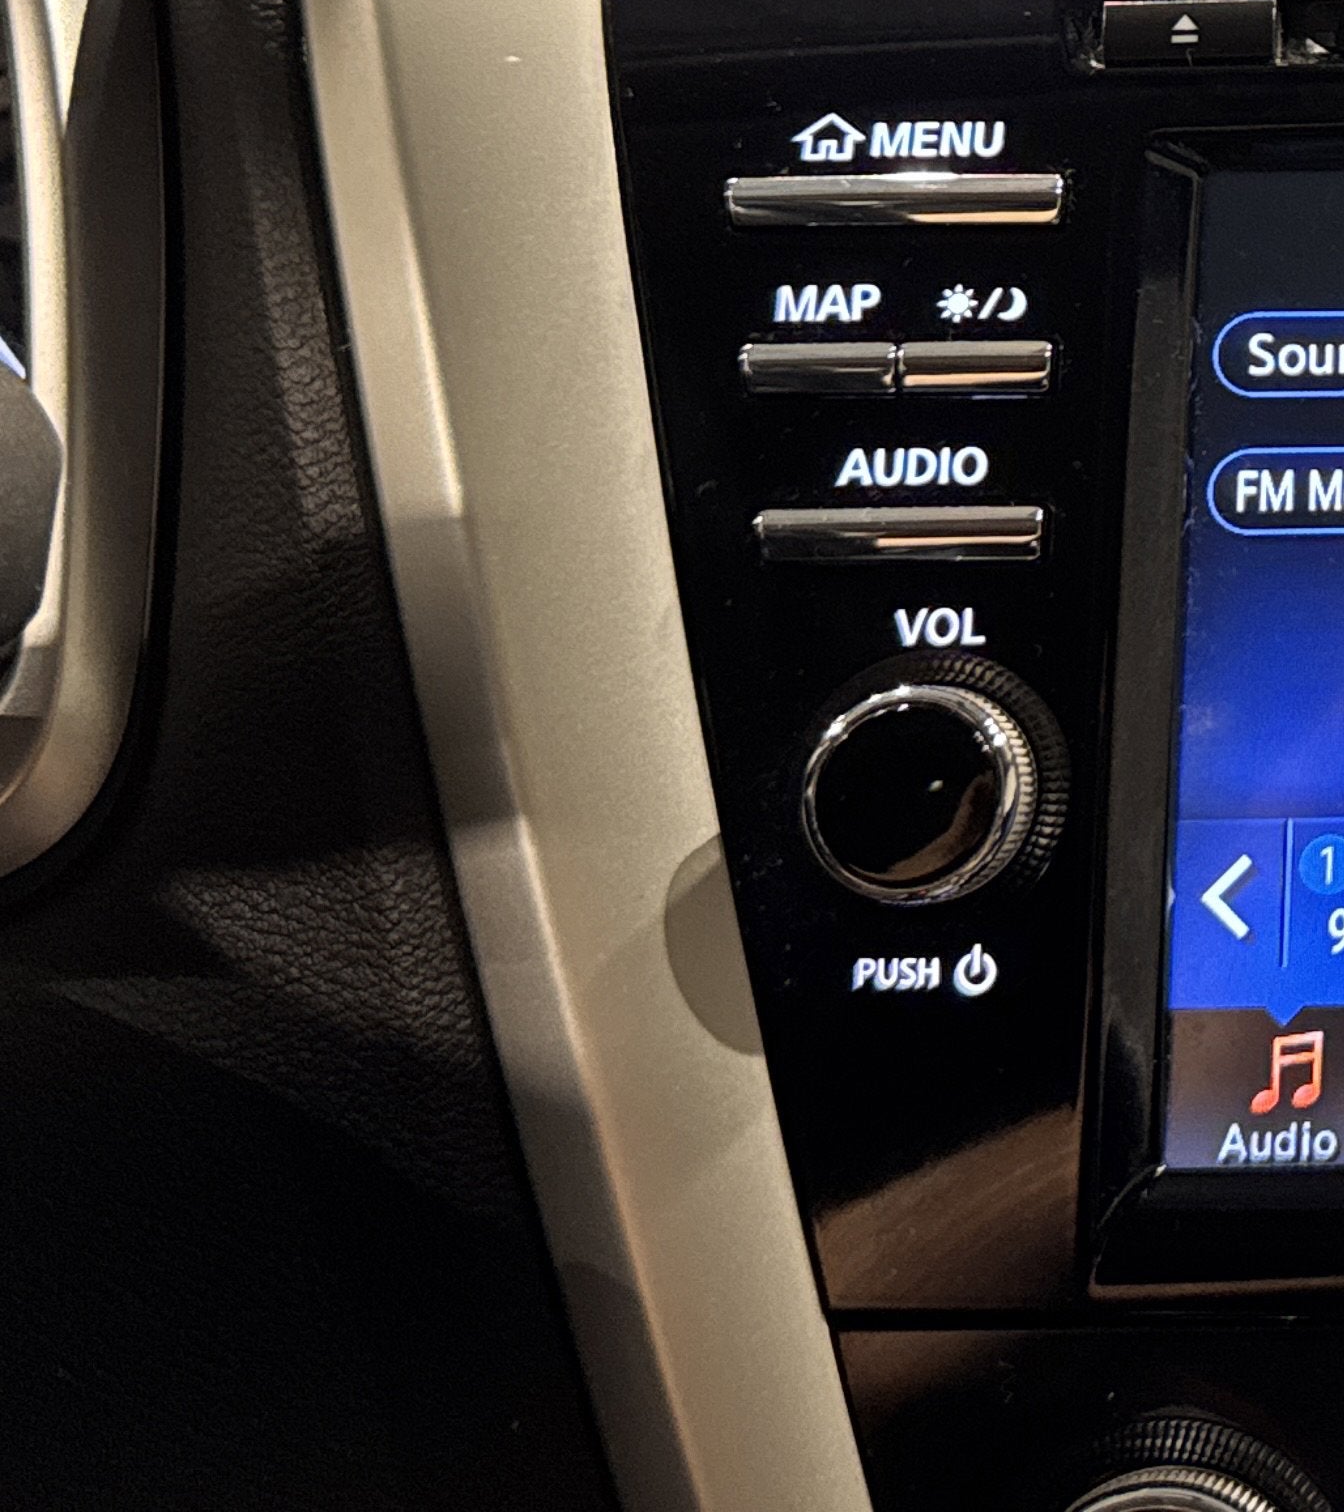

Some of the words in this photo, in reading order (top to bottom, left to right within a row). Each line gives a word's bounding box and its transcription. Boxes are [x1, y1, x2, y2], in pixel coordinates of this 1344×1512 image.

[869, 120, 1005, 159] MENU
[774, 283, 882, 323] MAP
[834, 446, 989, 487] AUDIO
[1235, 468, 1295, 513] FM
[894, 607, 986, 647] VOL
[1320, 846, 1334, 885] 1
[852, 956, 941, 991] PUSH
[1217, 1120, 1338, 1163] Audio
